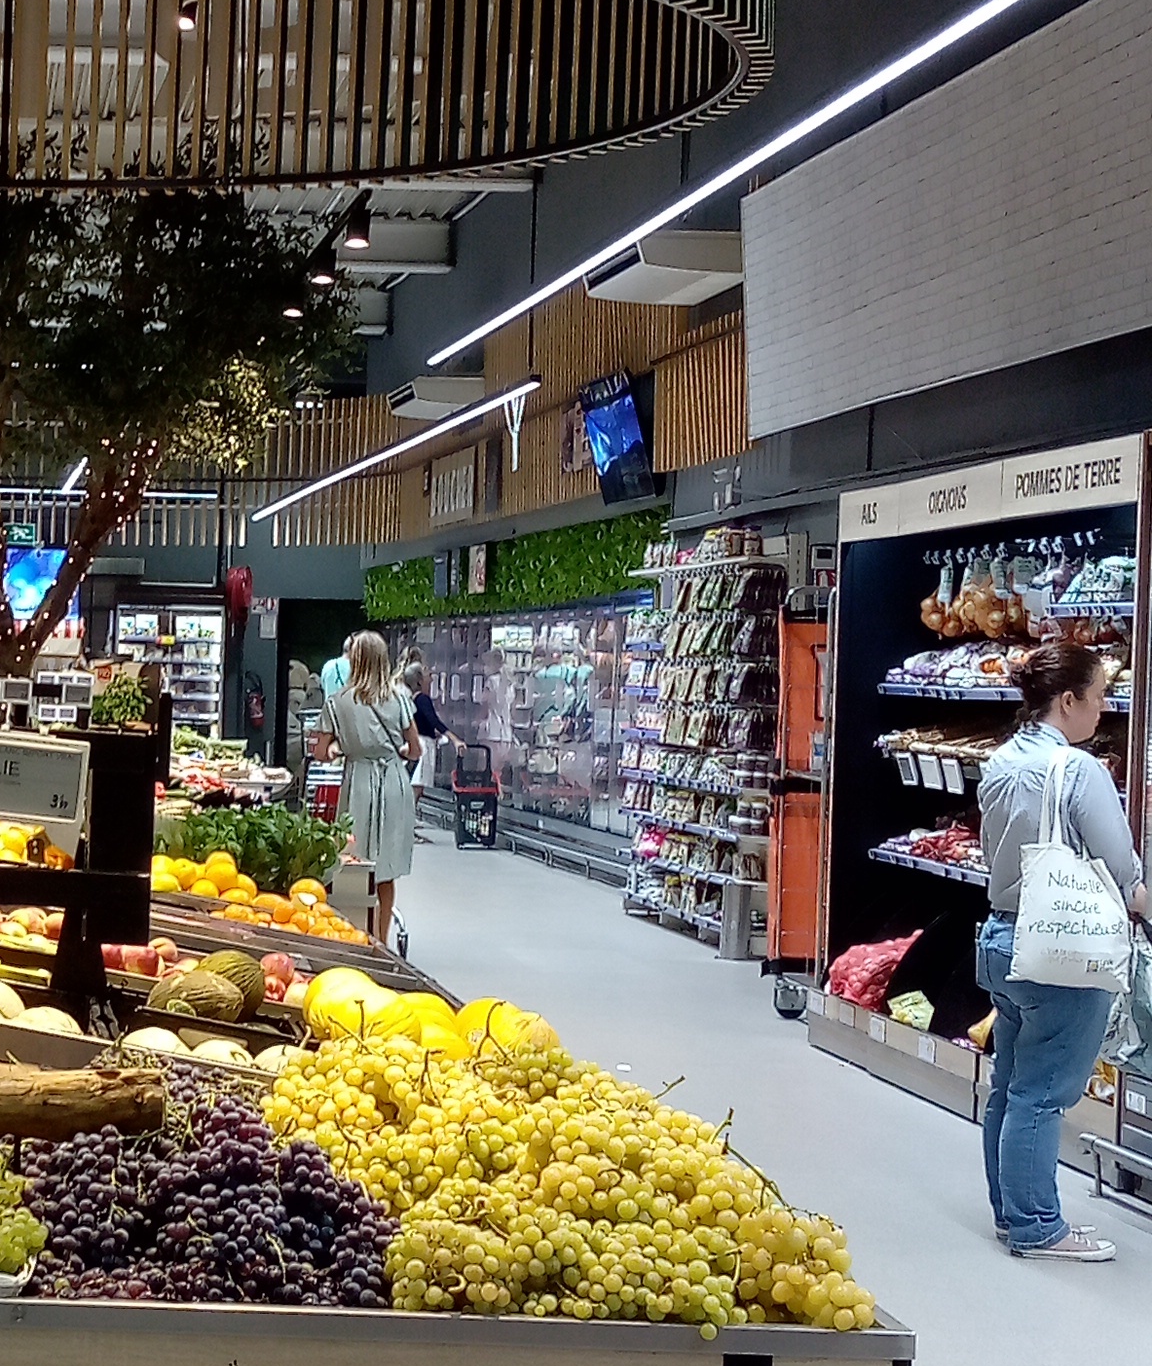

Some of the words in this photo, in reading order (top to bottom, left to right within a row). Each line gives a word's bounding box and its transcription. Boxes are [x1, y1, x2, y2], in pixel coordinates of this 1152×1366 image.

[1014, 467, 1062, 499] POMMES
[1064, 463, 1082, 491] DE
[1084, 456, 1123, 489] TERRE
[927, 485, 969, 515] OIGNONS
